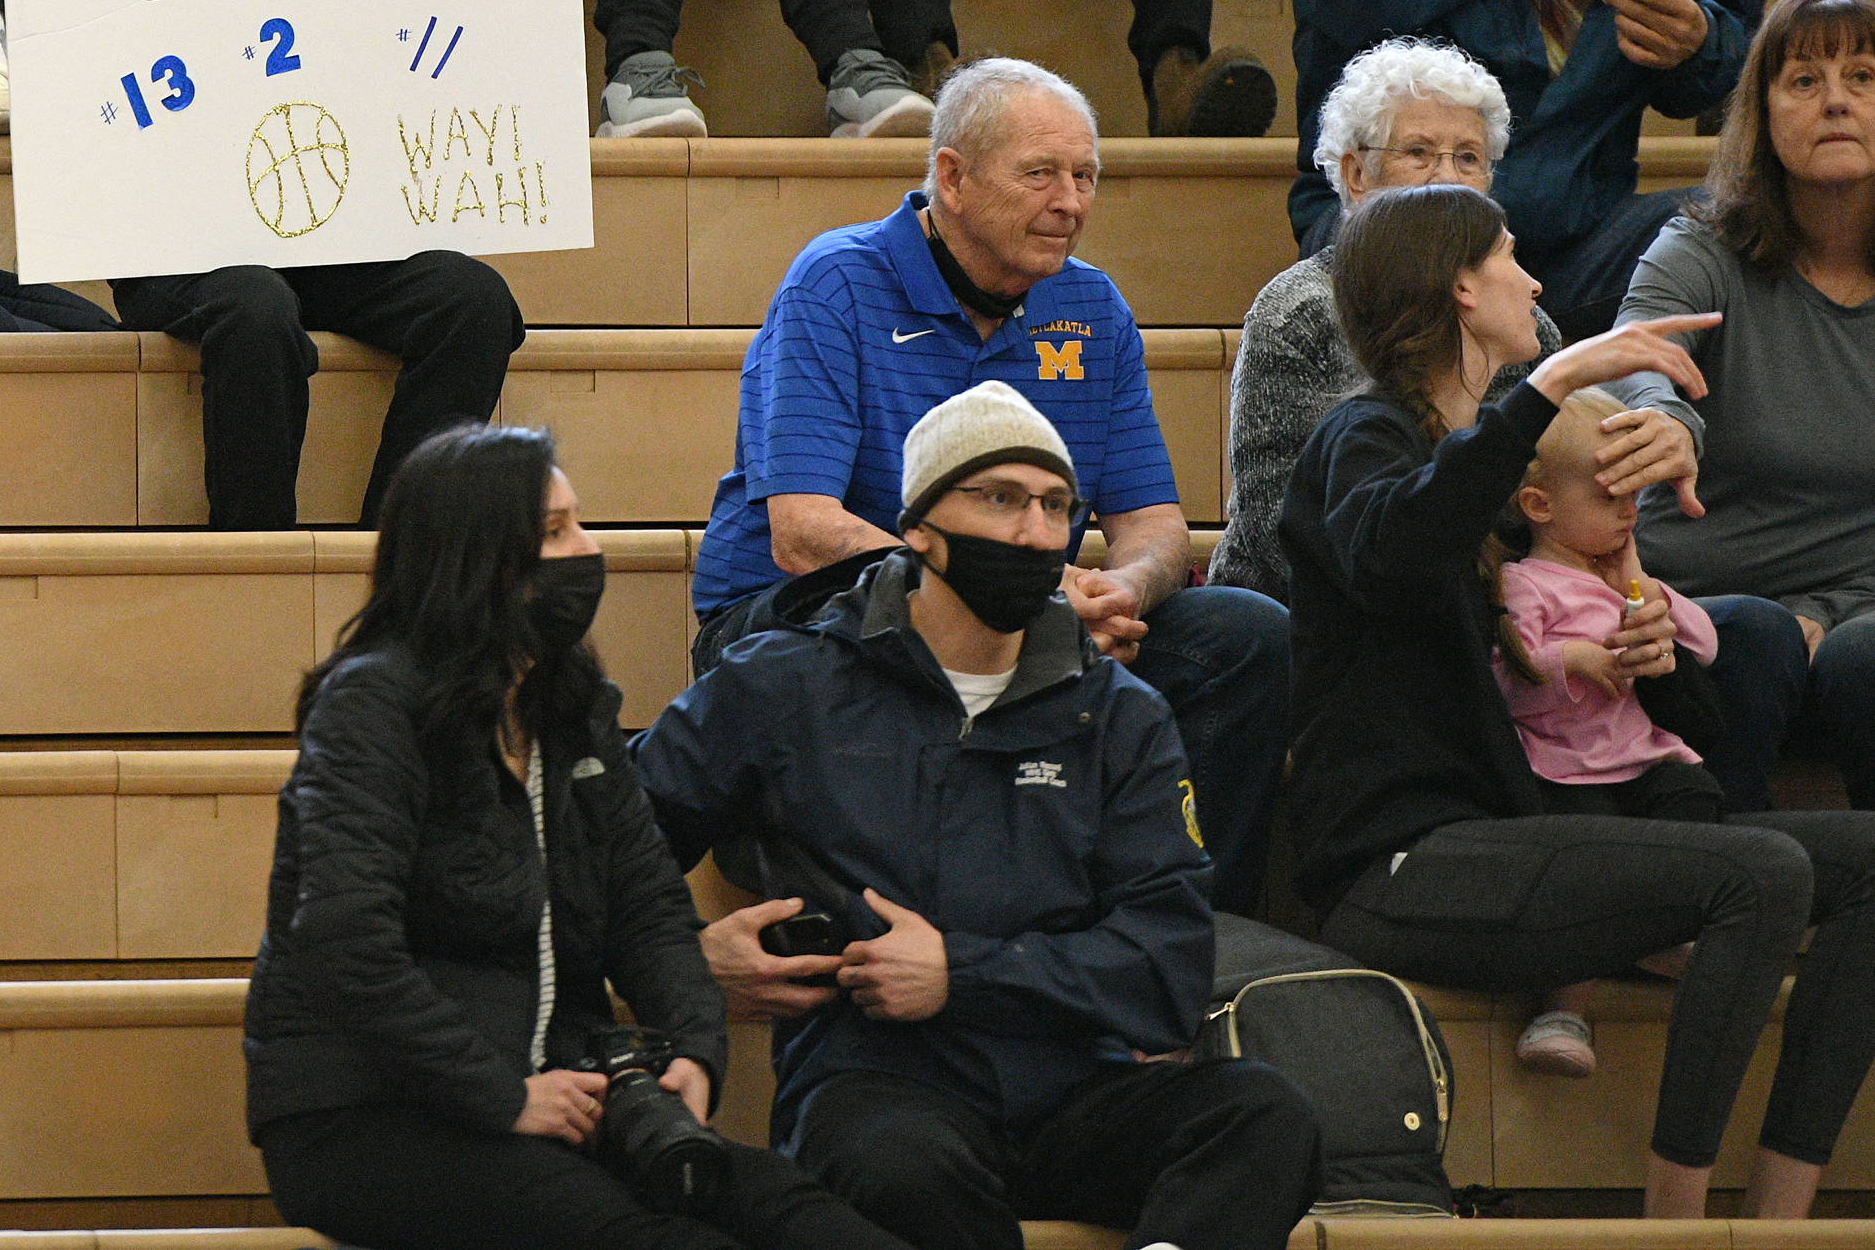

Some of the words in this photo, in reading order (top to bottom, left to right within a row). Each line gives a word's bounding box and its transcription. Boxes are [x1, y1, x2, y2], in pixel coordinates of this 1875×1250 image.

[100, 53, 197, 131] #13
[241, 16, 303, 78] #2
[400, 159, 548, 227] WAH!
[1034, 340, 1085, 380] M
